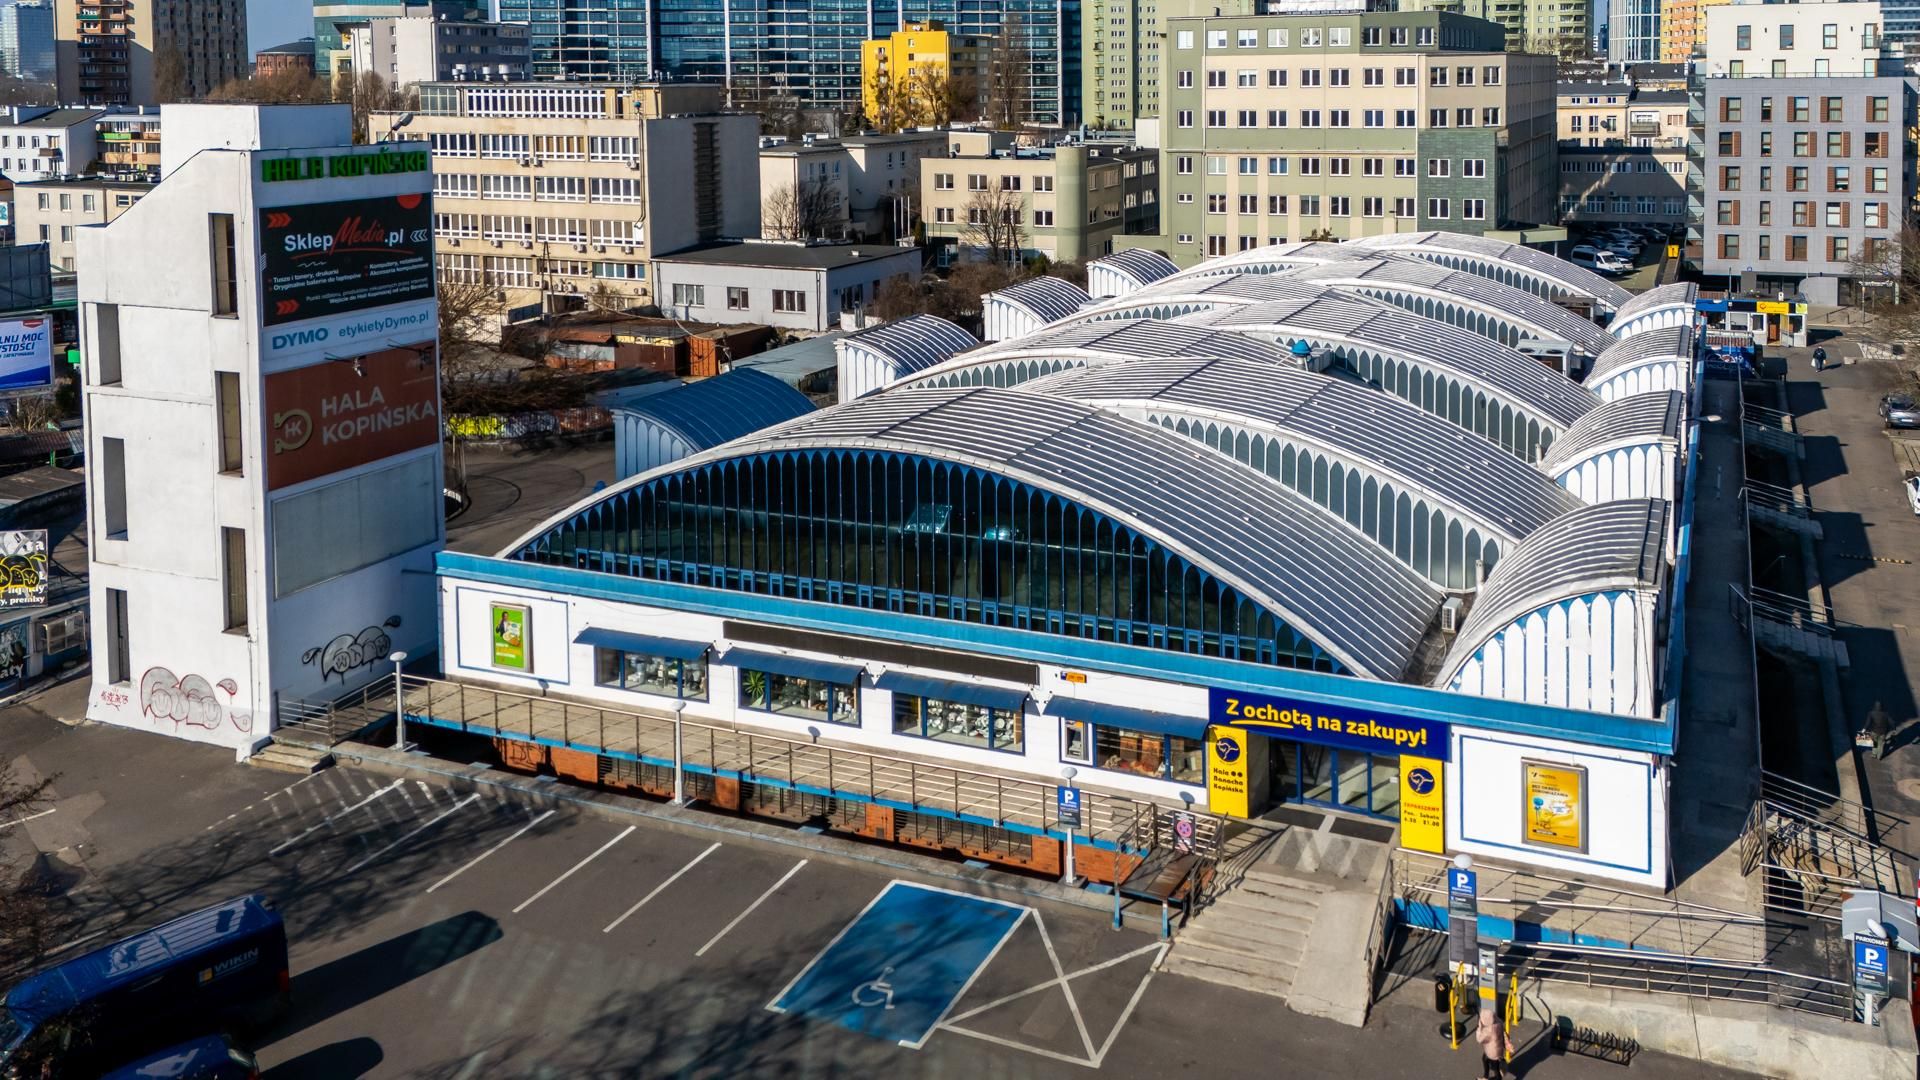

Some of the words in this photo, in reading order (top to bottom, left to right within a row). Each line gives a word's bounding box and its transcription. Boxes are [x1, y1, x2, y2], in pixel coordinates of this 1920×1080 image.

[262, 157, 324, 182] HALA
[329, 147, 428, 177] KOPIŃSKA
[295, 273, 315, 281] tonery,
[273, 281, 306, 292] Oryginalne
[21, 332, 44, 342] MOC
[272, 327, 329, 350] DYMO
[338, 311, 429, 337] etykietyDymo.pl
[321, 386, 385, 418] HALA
[322, 400, 436, 446] KOPIŃSKA
[1226, 698, 1239, 716] Z
[1244, 704, 1313, 731] ochotą
[1317, 716, 1342, 733] na
[1346, 720, 1428, 748] zakupy!
[1213, 767, 1230, 776] Hala
[1213, 775, 1244, 786] Banacha
[1213, 783, 1244, 794] Kopińska
[1064, 790, 1074, 803] P
[1456, 872, 1469, 888] P
[1856, 935, 1888, 947] PARKOMAT
[1865, 948, 1879, 964] P
